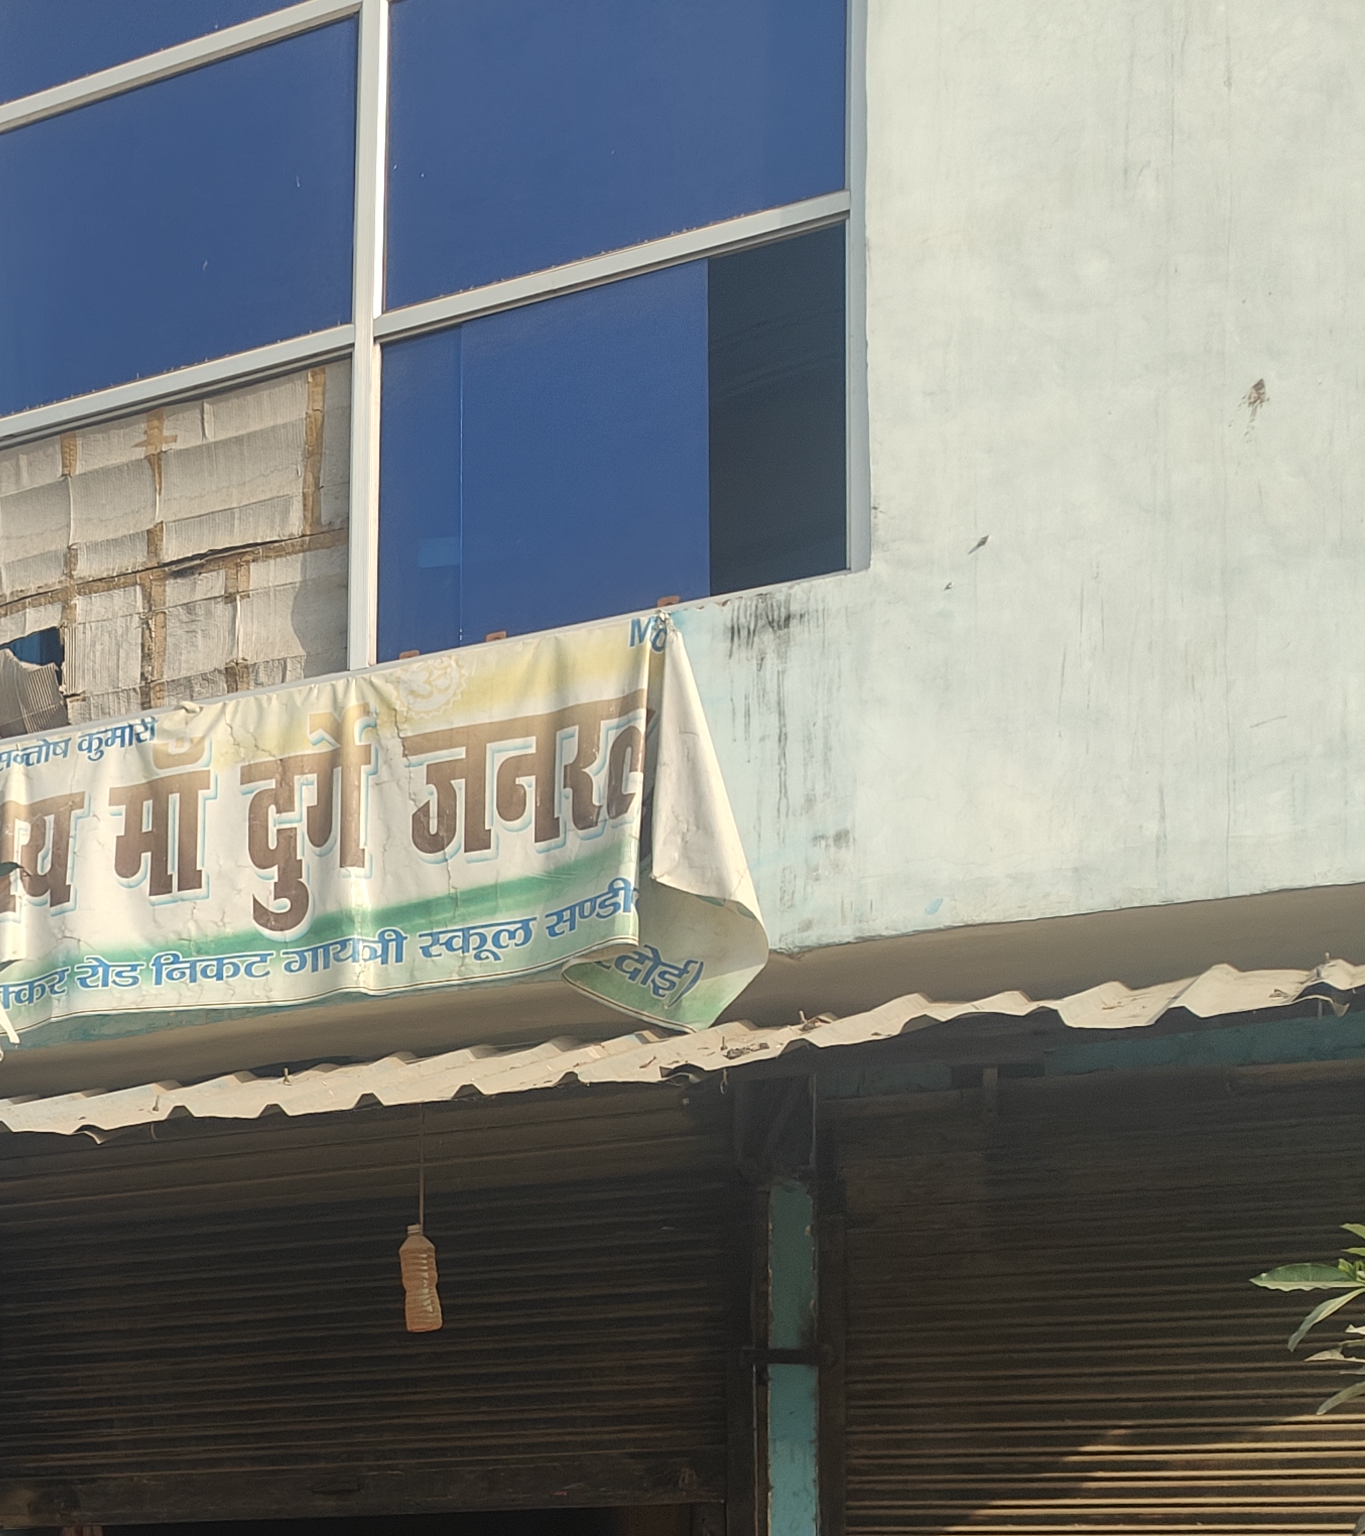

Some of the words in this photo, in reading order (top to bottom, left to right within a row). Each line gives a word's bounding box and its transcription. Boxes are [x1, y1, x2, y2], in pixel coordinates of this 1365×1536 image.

[75, 955, 144, 989] रोड
[151, 952, 275, 986] निकट
[418, 916, 538, 962] स्कूल
[544, 877, 639, 938] सण्डी
